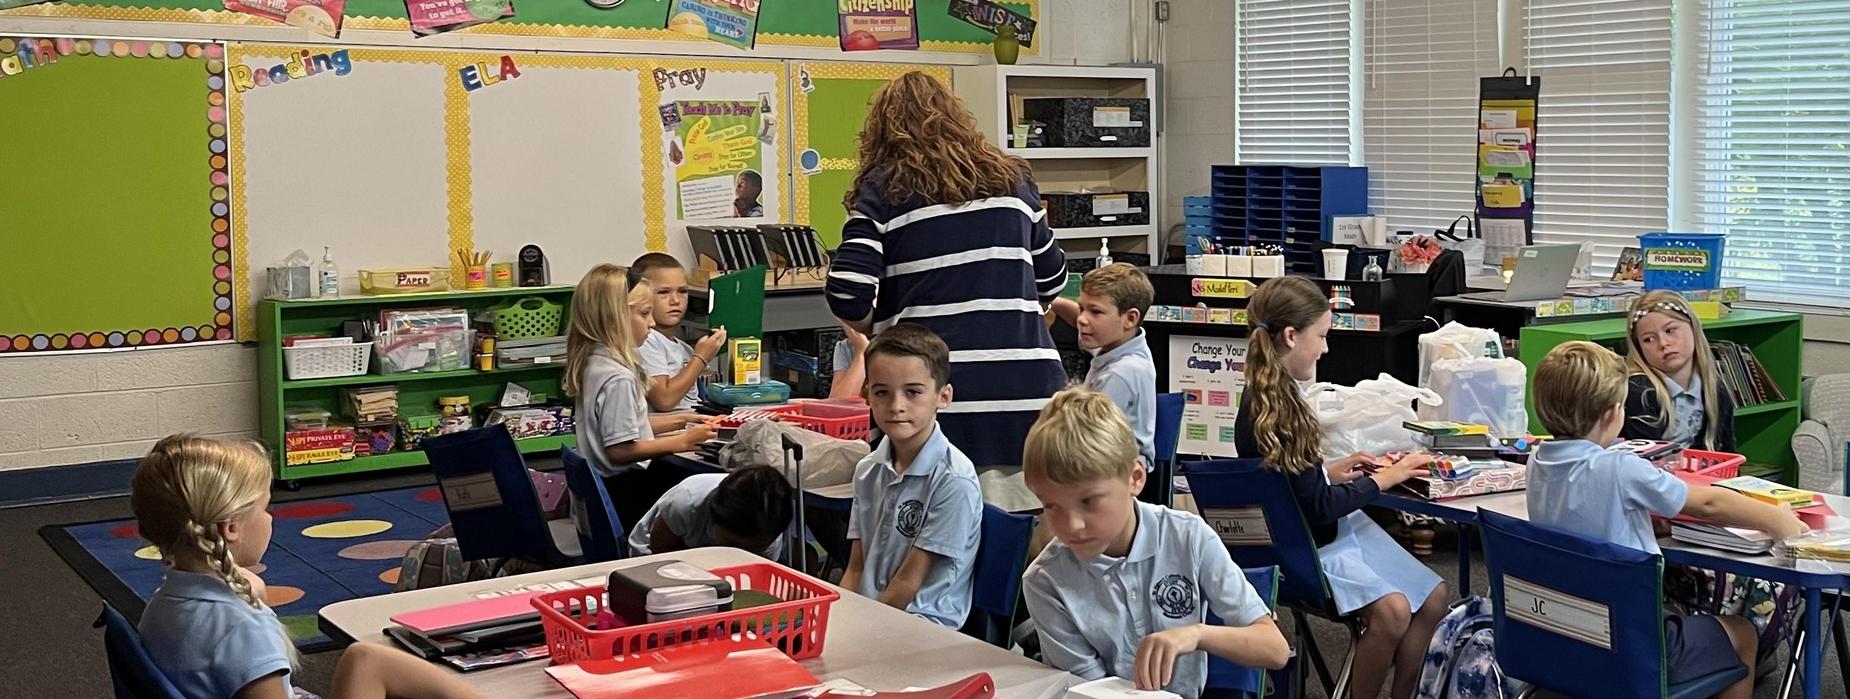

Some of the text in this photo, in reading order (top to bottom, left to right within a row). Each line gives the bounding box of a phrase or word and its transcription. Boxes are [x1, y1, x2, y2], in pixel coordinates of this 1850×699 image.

[439, 9, 455, 18] get
[0, 38, 57, 77] ath
[228, 49, 352, 93] Reading
[458, 55, 521, 92] ELA
[653, 67, 706, 91] Pray
[732, 101, 756, 118] Pray
[1654, 255, 1703, 264] HOMEWORK
[1192, 342, 1246, 359] Change Your
[1187, 356, 1244, 374] Change You
[1216, 519, 1245, 534] Charlotte
[1531, 597, 1546, 615] JC
